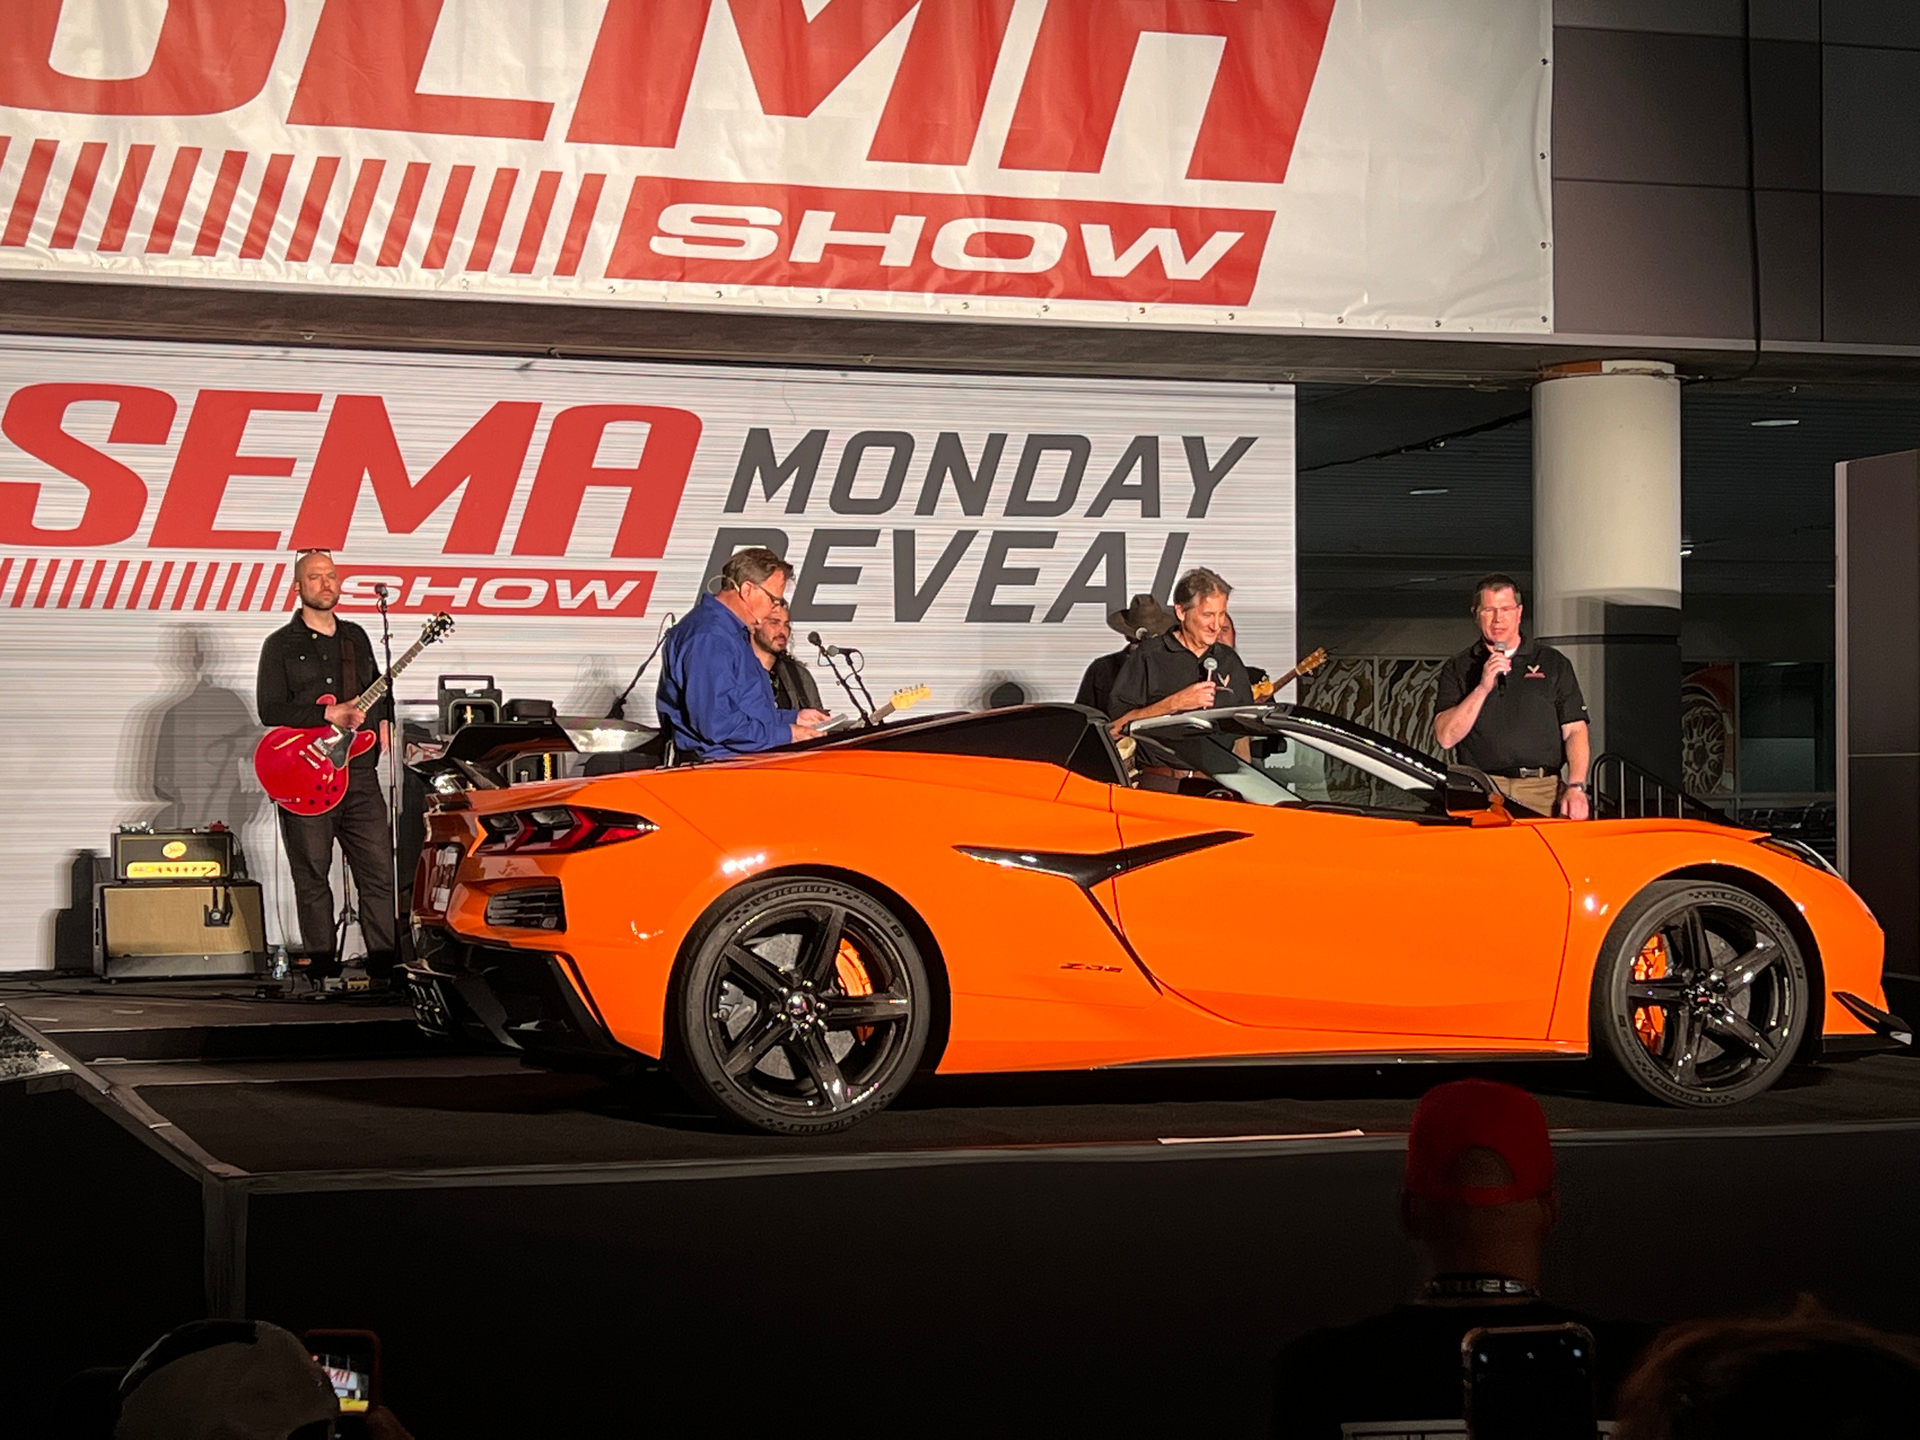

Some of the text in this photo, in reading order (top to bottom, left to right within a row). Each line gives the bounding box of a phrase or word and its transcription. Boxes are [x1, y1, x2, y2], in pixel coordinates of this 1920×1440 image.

[649, 202, 1245, 281] SHOW
[0, 382, 703, 559] SEMA
[722, 427, 1259, 519] MONDAY
[339, 574, 641, 610] SHOW
